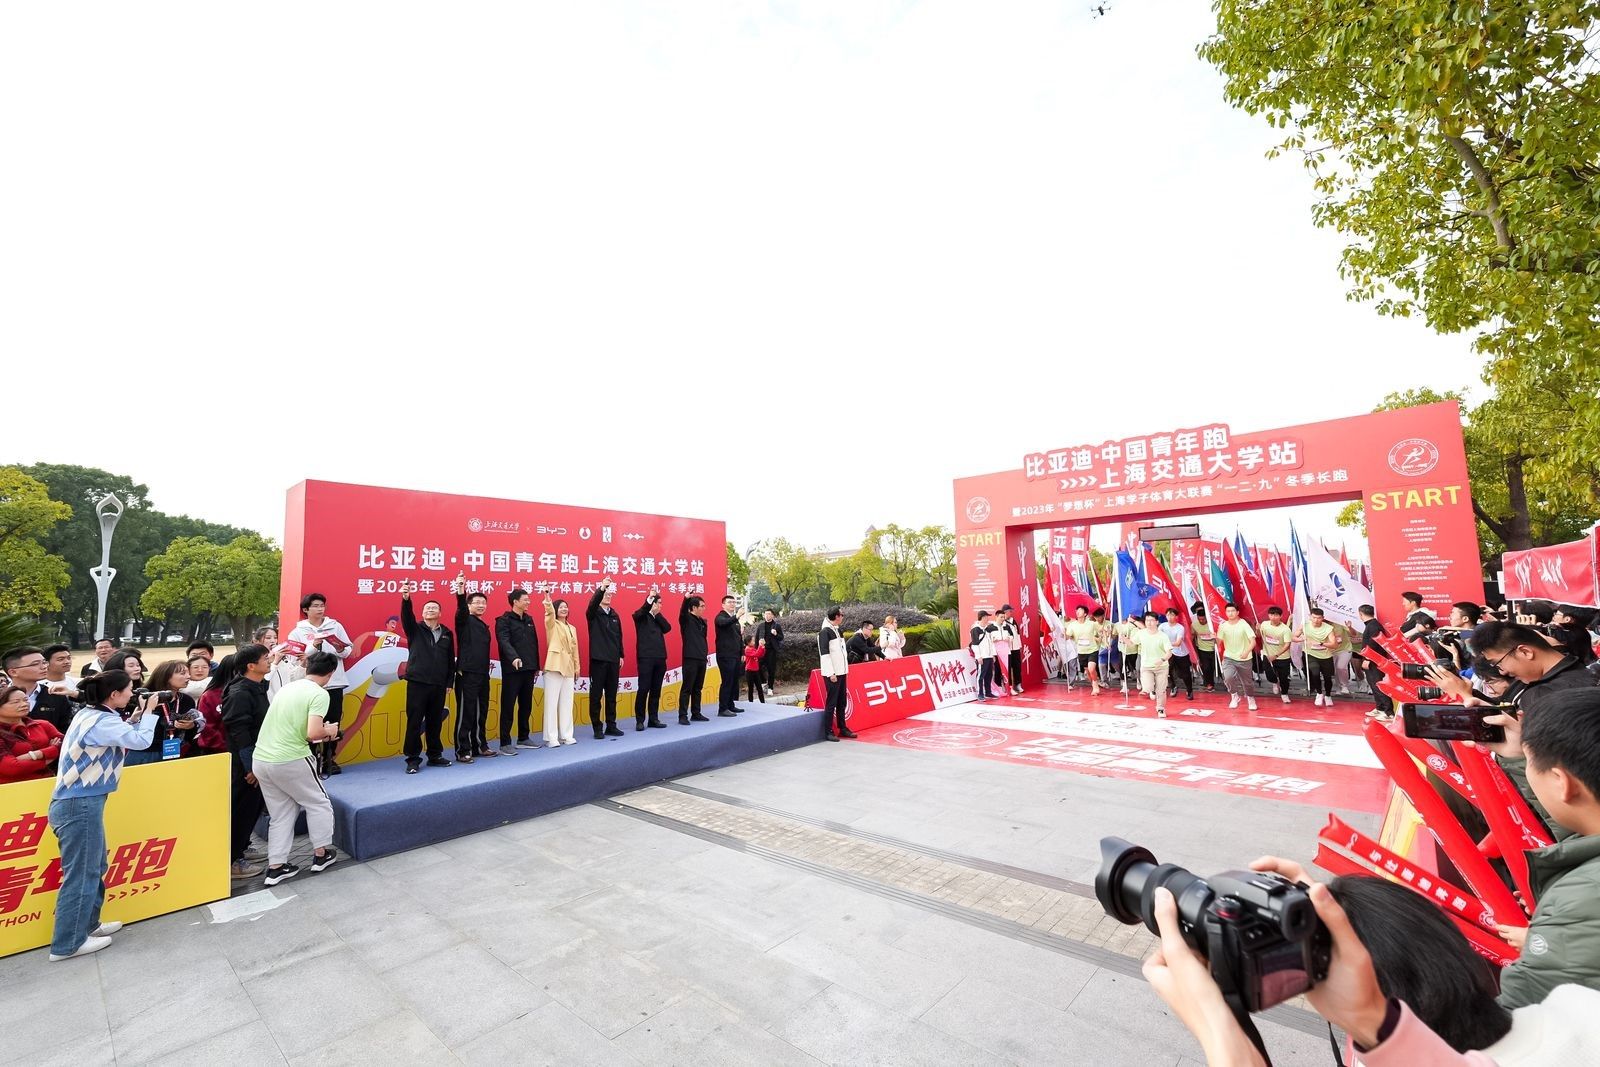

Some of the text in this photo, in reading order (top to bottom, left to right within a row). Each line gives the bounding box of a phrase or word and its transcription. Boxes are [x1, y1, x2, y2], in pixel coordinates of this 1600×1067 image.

[1026, 427, 1229, 478] 比亚迪·中国青年跑
[1099, 440, 1297, 489] 上海交通大学站
[1370, 486, 1461, 511] START
[537, 525, 567, 535] BYD
[959, 531, 1002, 548] START
[358, 544, 705, 577] 比亚迪·中国青年跑上海交通大学站
[384, 635, 396, 646] 54
[864, 673, 926, 706] BYD
